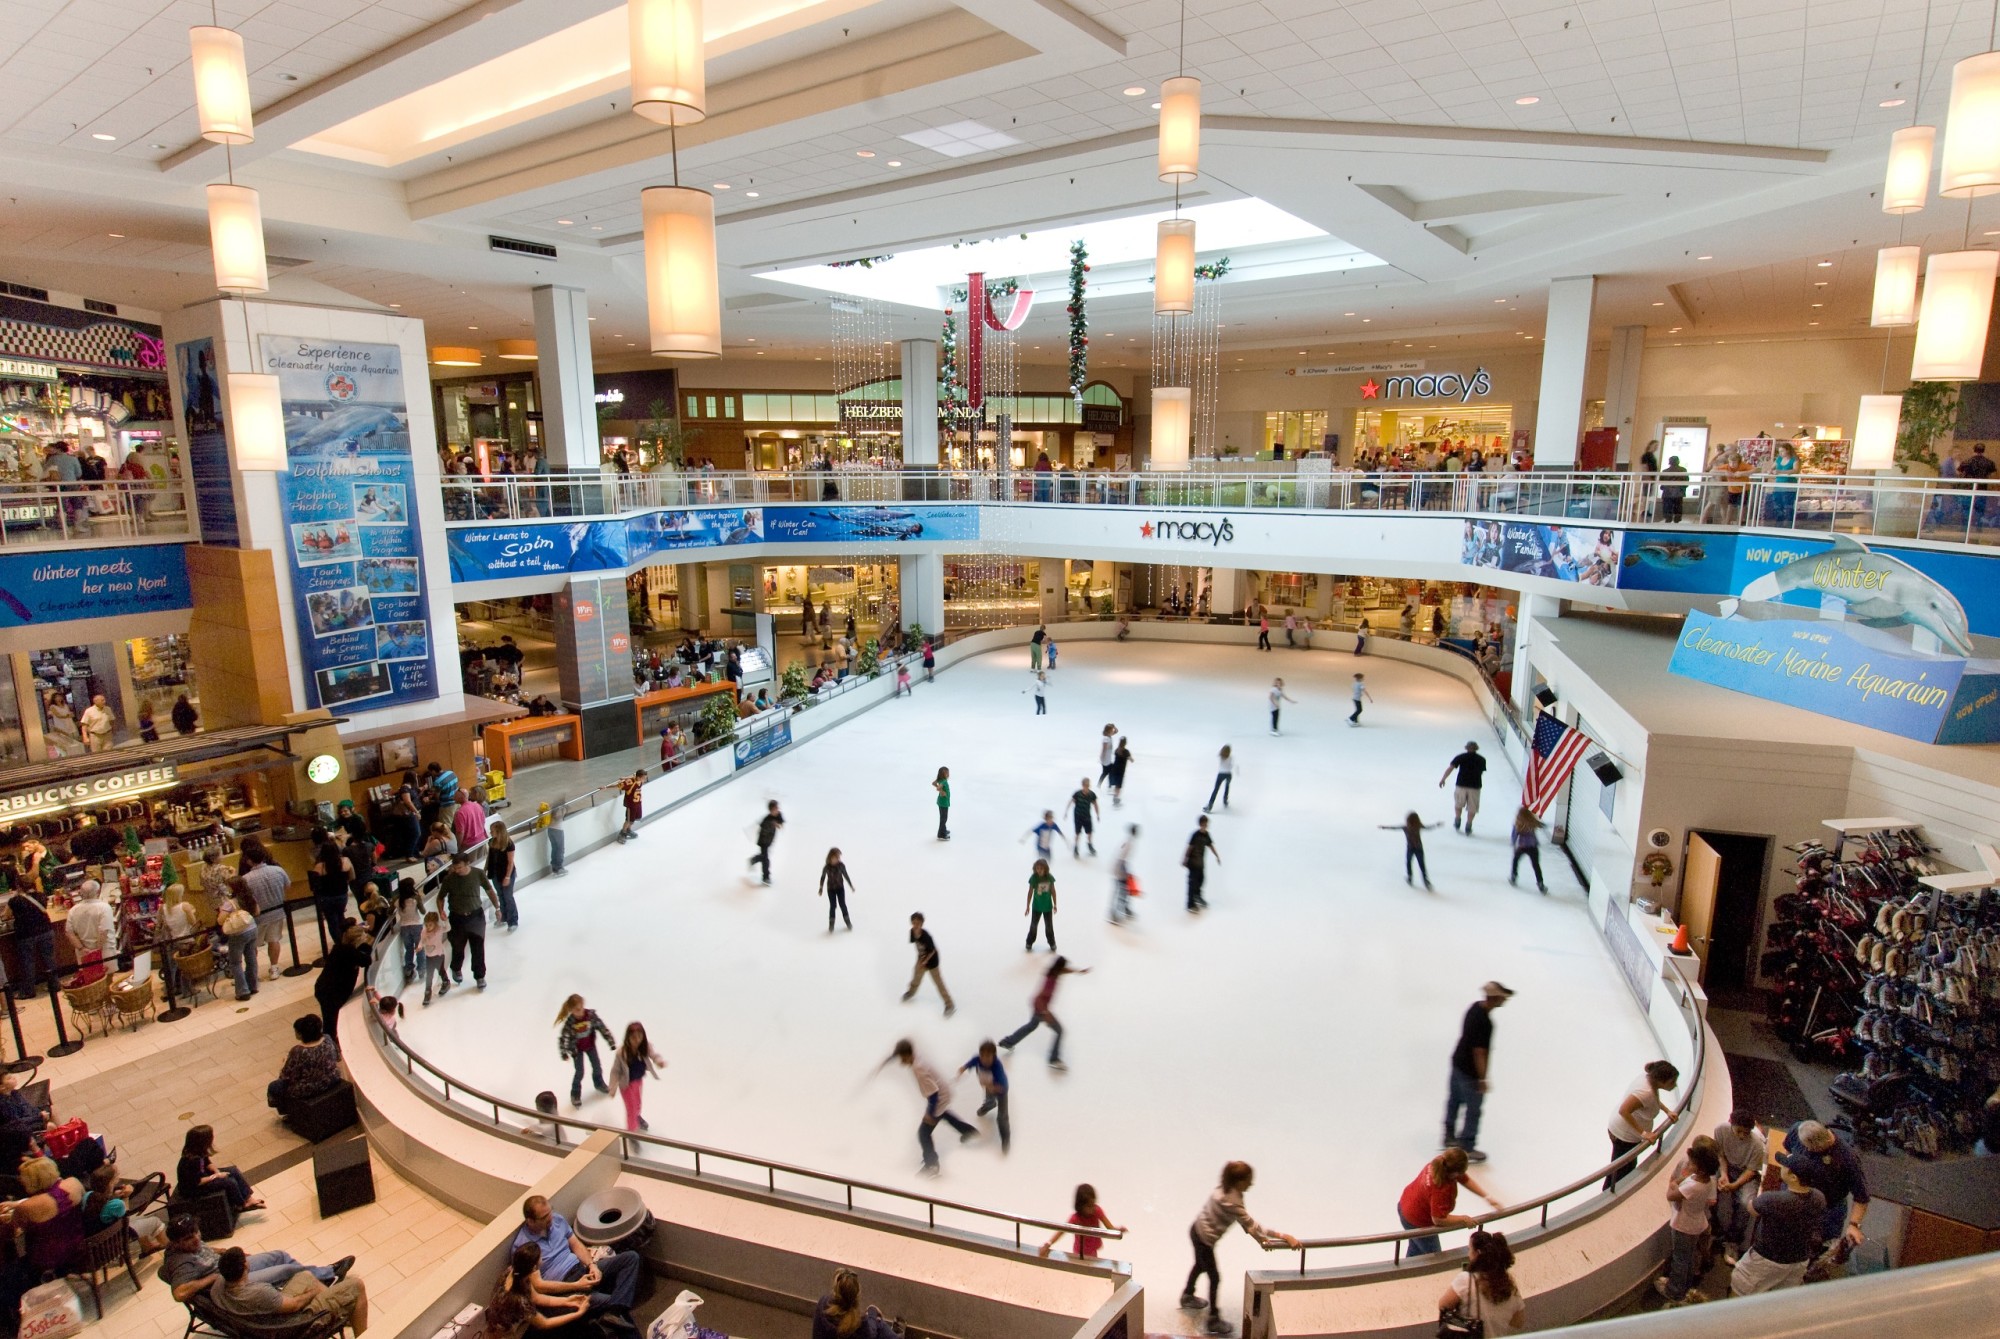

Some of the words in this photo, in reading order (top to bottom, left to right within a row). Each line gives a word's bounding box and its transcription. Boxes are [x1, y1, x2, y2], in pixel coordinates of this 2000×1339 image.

[297, 343, 372, 362] Experience
[268, 358, 324, 372] Clearwater
[327, 362, 358, 373] Marine
[361, 365, 399, 376] Aquarium
[1384, 366, 1490, 403] macy's
[294, 463, 350, 481] Dolphin
[354, 464, 401, 477] Shows!
[297, 490, 337, 503] Dolphin
[289, 502, 324, 511] Photo
[327, 502, 349, 513] Ops
[777, 519, 800, 529] Winter
[465, 532, 490, 543] Winter
[492, 532, 519, 542] Learns
[520, 530, 529, 540] to
[1157, 517, 1234, 546] macy's
[1506, 527, 1535, 542] Winter's
[371, 536, 402, 546] Dolphin
[501, 535, 554, 557] Swim
[371, 545, 408, 555] Programs
[1746, 547, 1772, 563] NOW
[488, 557, 517, 570] without
[526, 555, 541, 566] tail
[32, 564, 81, 582] Winter
[86, 557, 133, 576] meets
[313, 567, 342, 577] Touch
[1812, 557, 1894, 591] Winter
[82, 579, 103, 594] her
[108, 581, 133, 593] new
[137, 575, 168, 592] Mom!
[308, 578, 351, 589] Stingrays
[39, 600, 95, 613] Clearwater
[377, 600, 418, 611] Eco-boat
[576, 605, 593, 615] WiFi
[388, 610, 410, 618] Tours
[330, 634, 360, 645] Behind
[1791, 631, 1810, 640] NOW
[322, 646, 336, 655] the
[339, 643, 369, 654] Scenes
[612, 638, 628, 647] WiFi
[338, 653, 360, 662] Tours
[398, 662, 427, 673] Marine
[1682, 623, 1780, 667] Clearwater
[1775, 648, 1844, 682] Marine
[1846, 663, 1949, 710] Aquarium
[403, 671, 423, 682] Life
[401, 680, 428, 690] Movies
[1955, 702, 1974, 720] NOW
[1975, 688, 1997, 709] OPEN!
[93, 766, 175, 793] COFFEE
[22, 1313, 68, 1339] Justice
